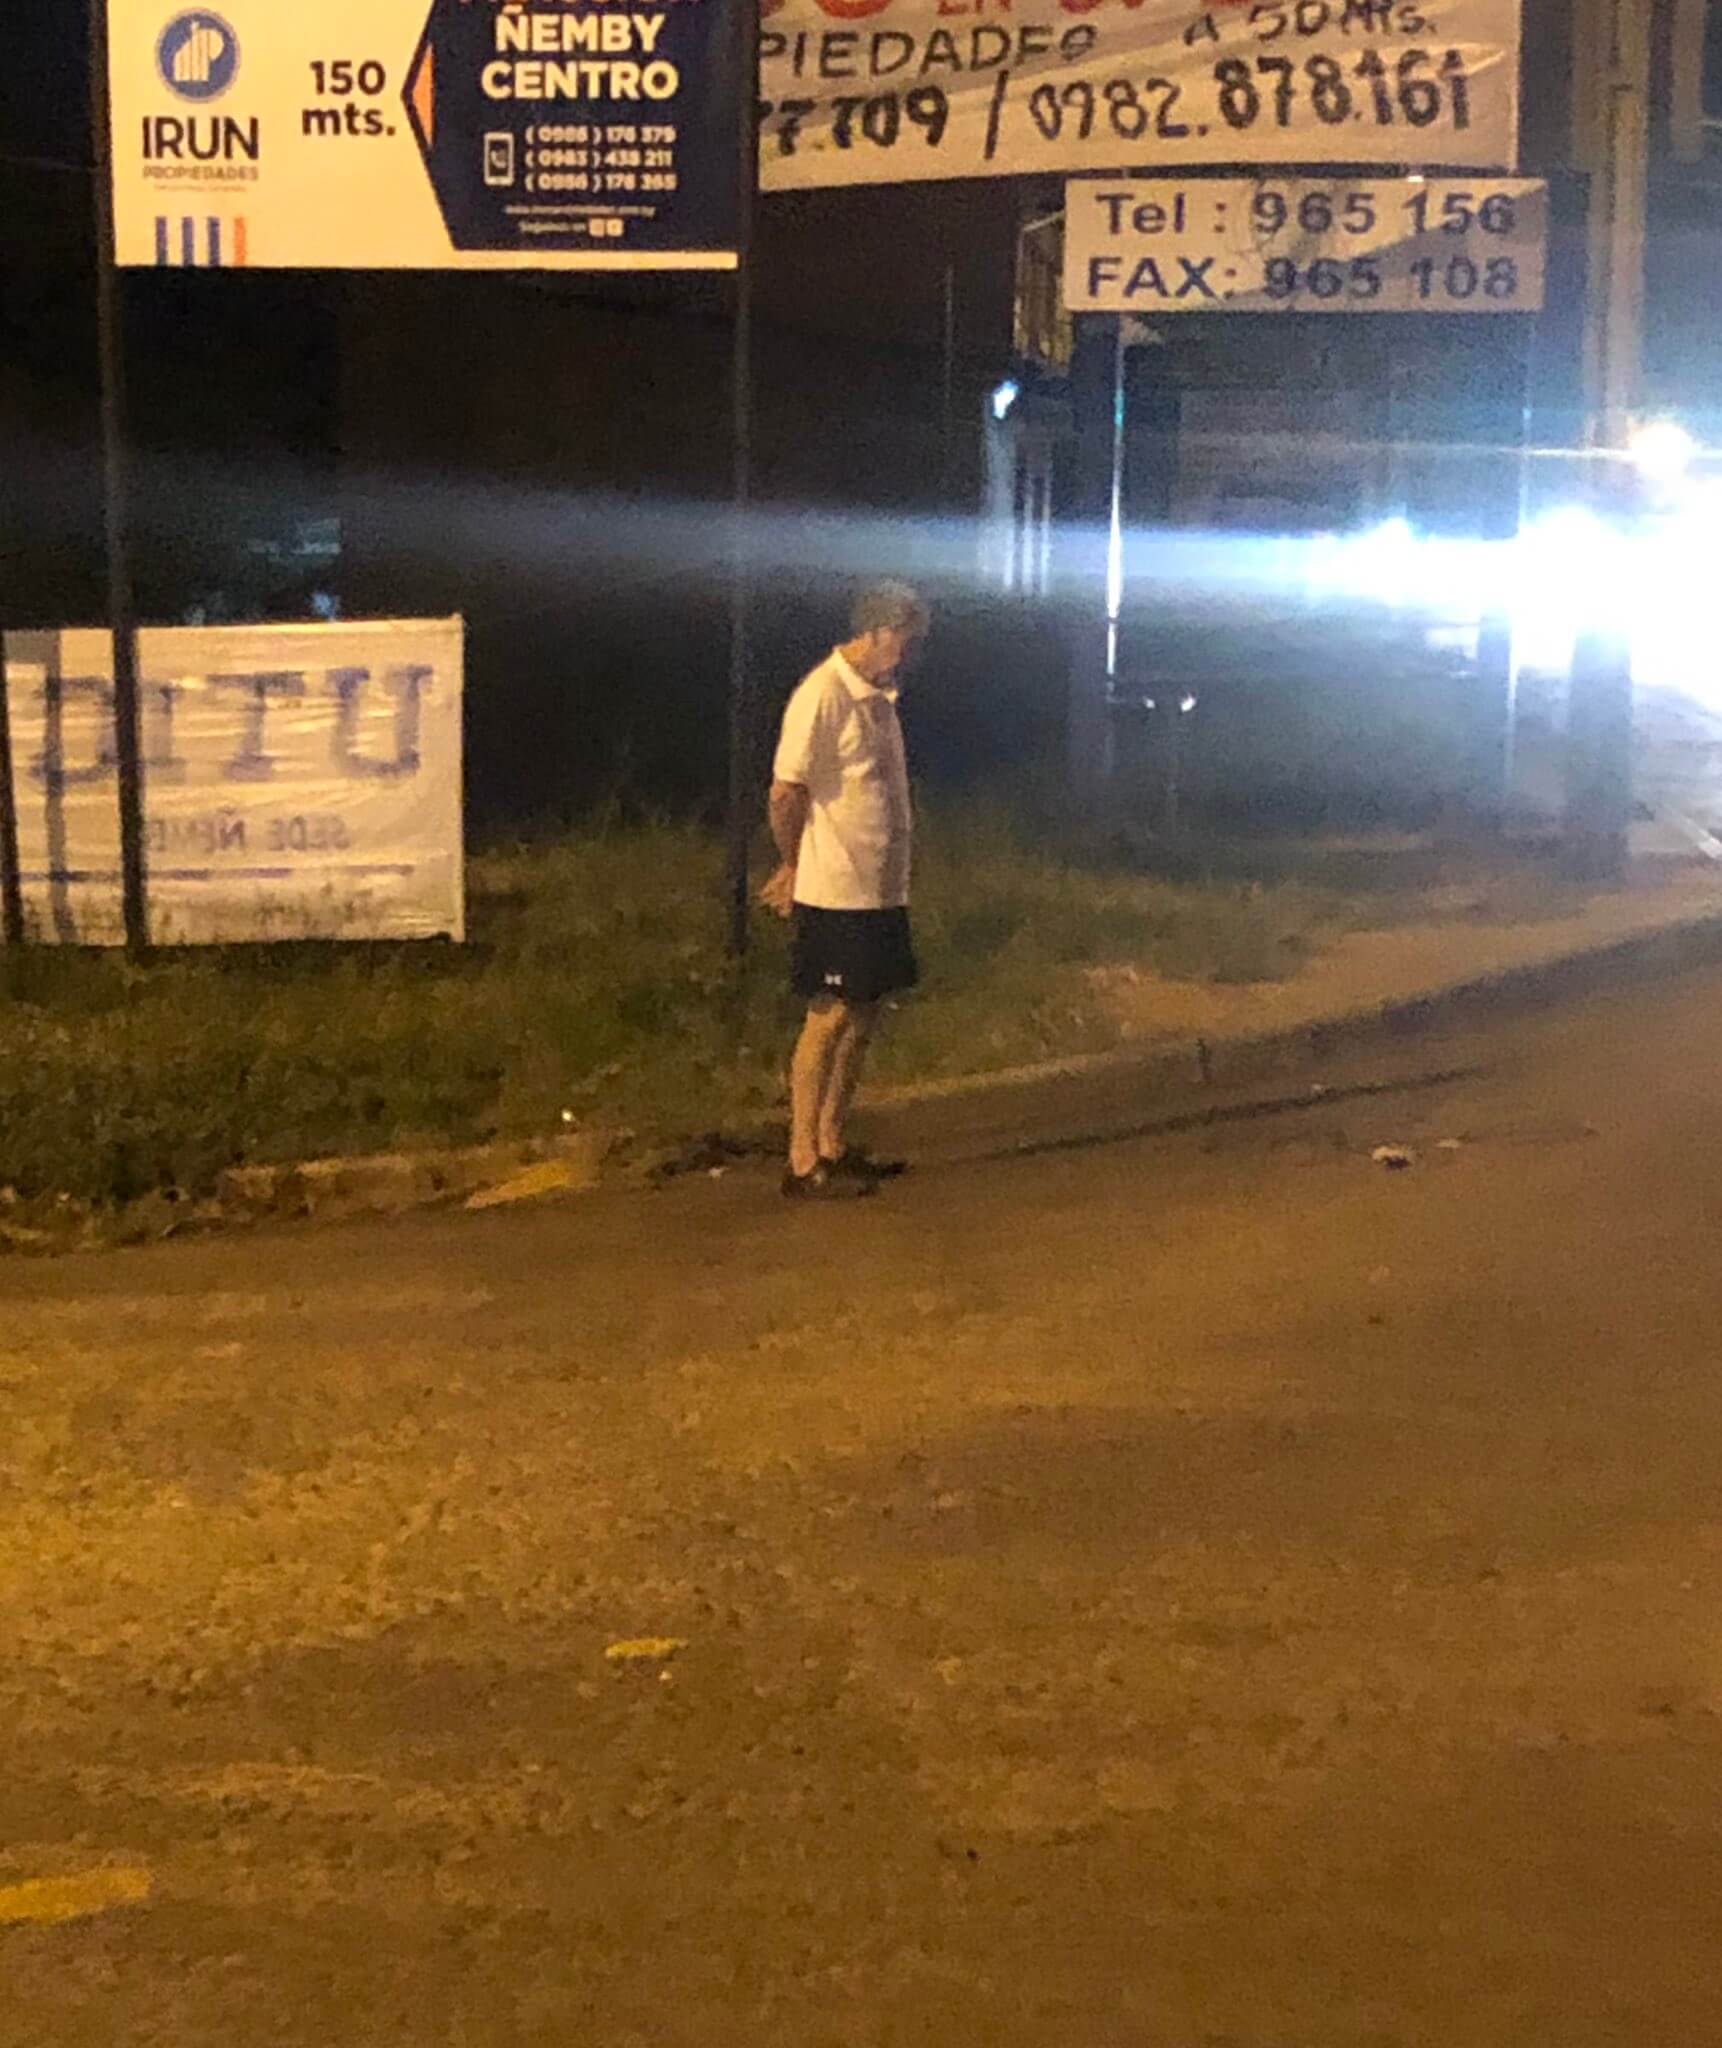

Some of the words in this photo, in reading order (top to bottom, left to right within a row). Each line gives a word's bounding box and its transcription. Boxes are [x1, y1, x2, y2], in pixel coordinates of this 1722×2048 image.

[495, 3, 666, 52] ÑEMBY
[310, 60, 386, 96] 150
[481, 60, 680, 100] CENTRO
[142, 116, 260, 160] IRUN
[302, 102, 396, 136] mts.
[1096, 192, 1186, 235] Tel
[1253, 191, 1377, 235] 965
[1402, 190, 1517, 234] 156
[1087, 256, 1236, 300] FAX:
[1263, 256, 1381, 299] 965
[1408, 256, 1518, 299] 108
